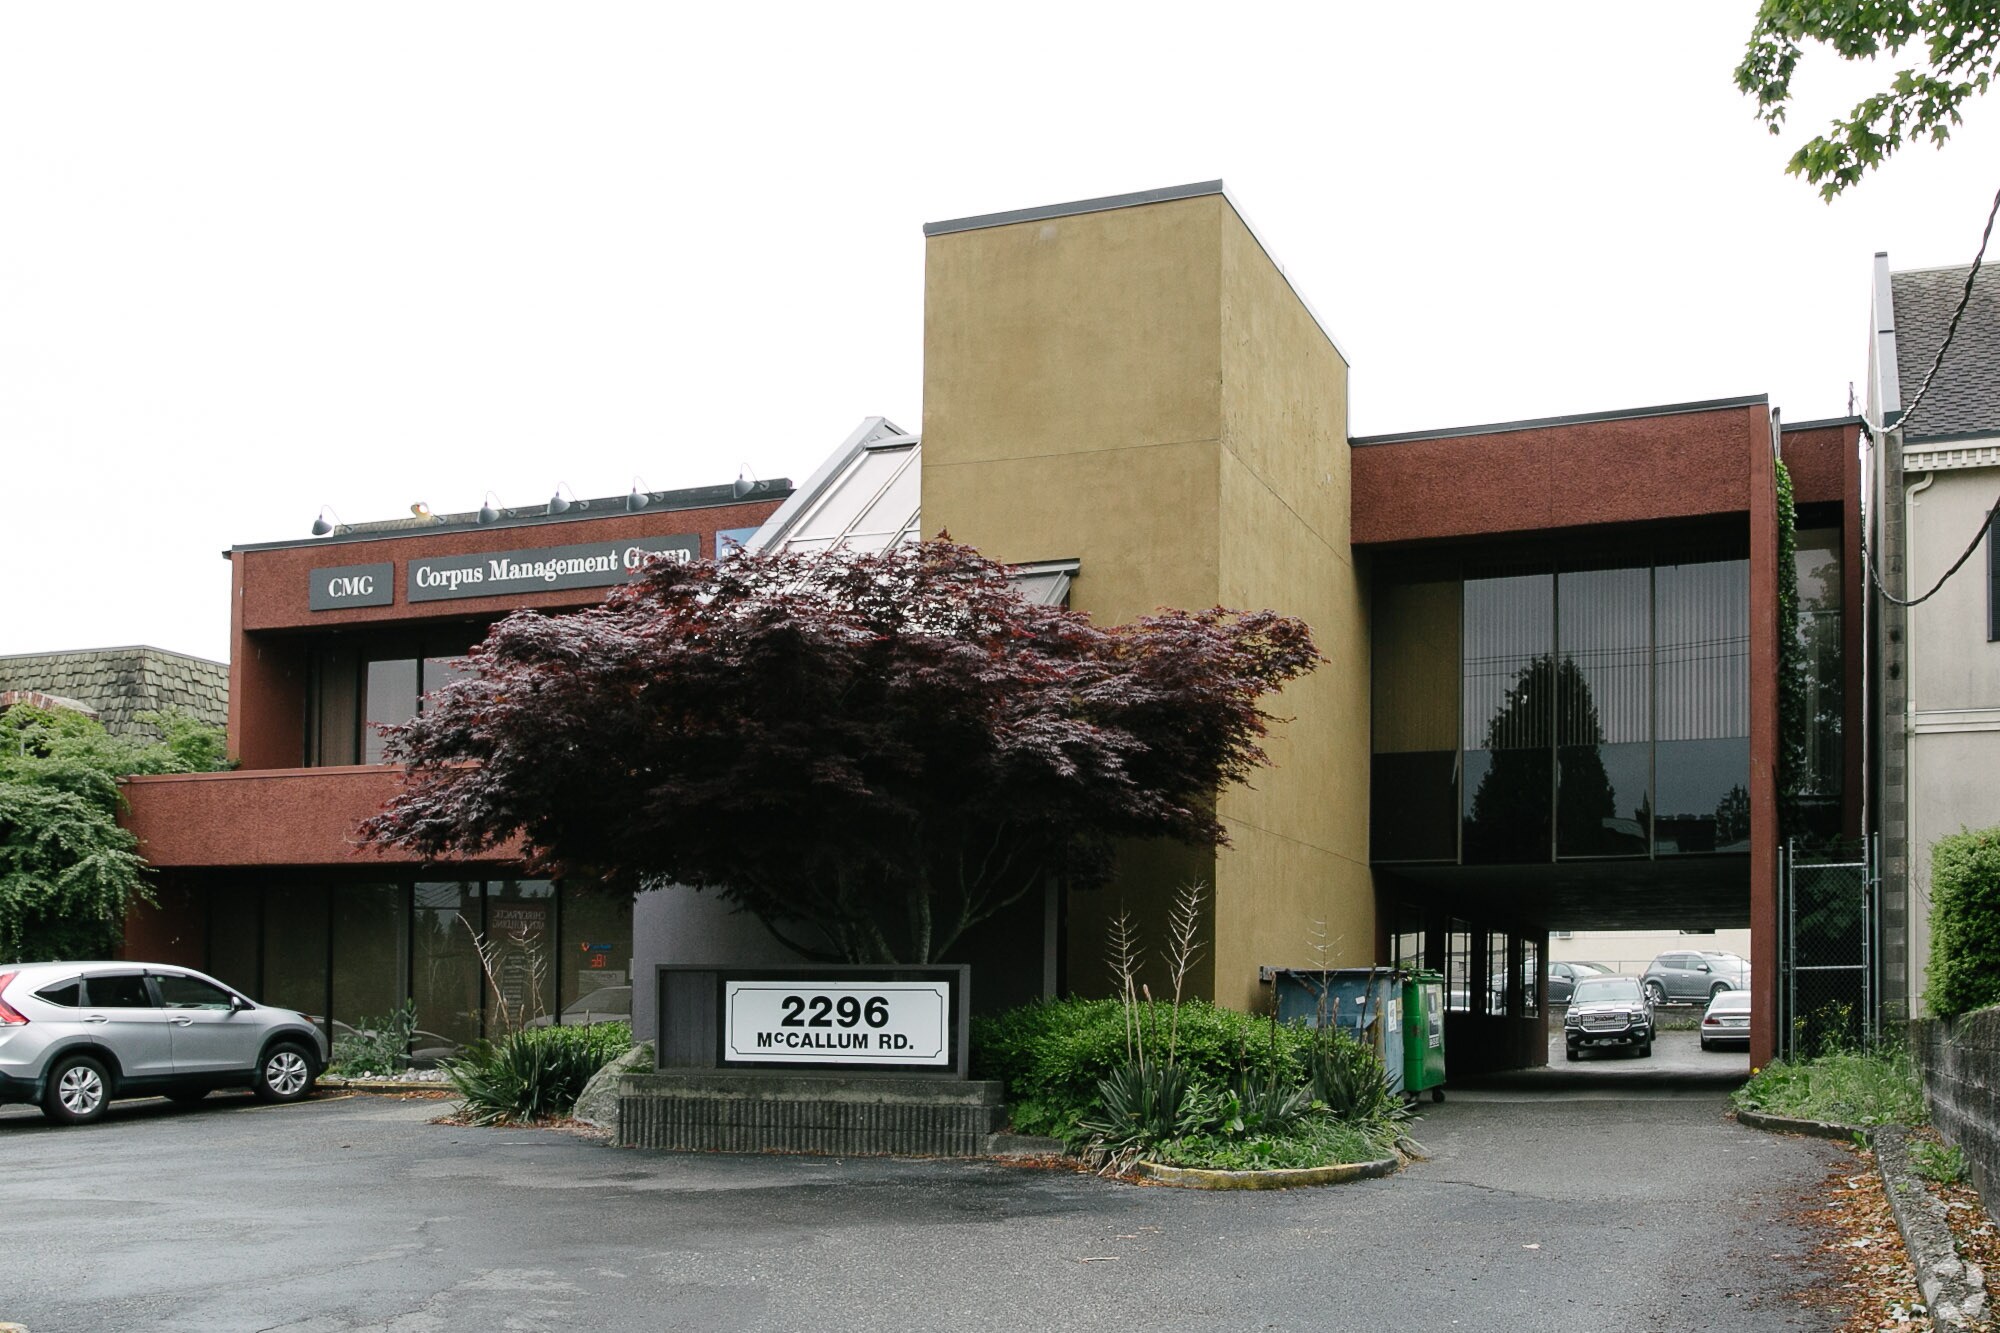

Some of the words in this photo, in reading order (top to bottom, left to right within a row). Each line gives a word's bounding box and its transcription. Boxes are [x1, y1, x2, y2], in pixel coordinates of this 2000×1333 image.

[416, 564, 483, 591] Corpus
[488, 548, 618, 586] Management
[328, 576, 374, 598] CMG
[781, 995, 889, 1028] 2296
[757, 1032, 868, 1049] McCALLUM
[879, 1034, 914, 1050] RD.
